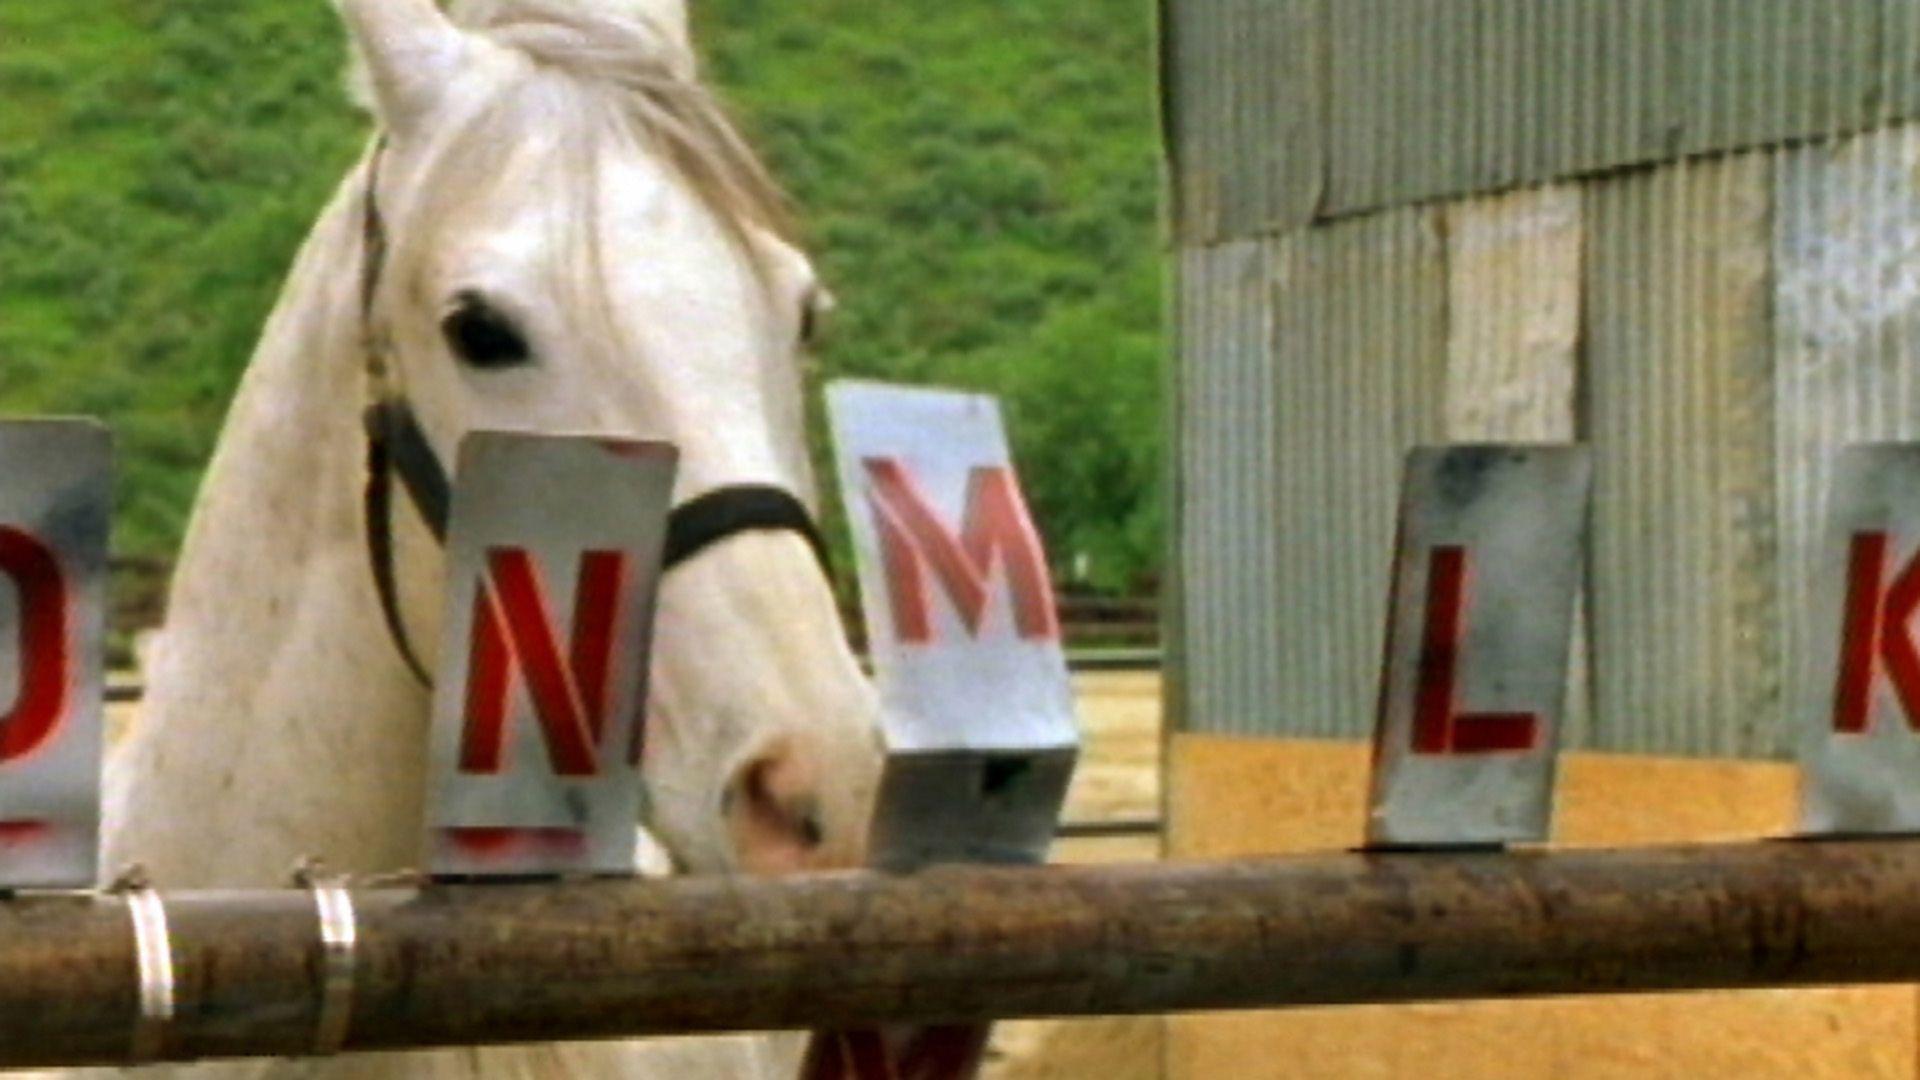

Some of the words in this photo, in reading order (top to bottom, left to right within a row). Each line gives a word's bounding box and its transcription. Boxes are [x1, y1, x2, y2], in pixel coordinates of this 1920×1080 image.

[861, 456, 1057, 642] M
[1411, 545, 1538, 755] L
[1831, 530, 1920, 734] K
[457, 546, 626, 776] N
